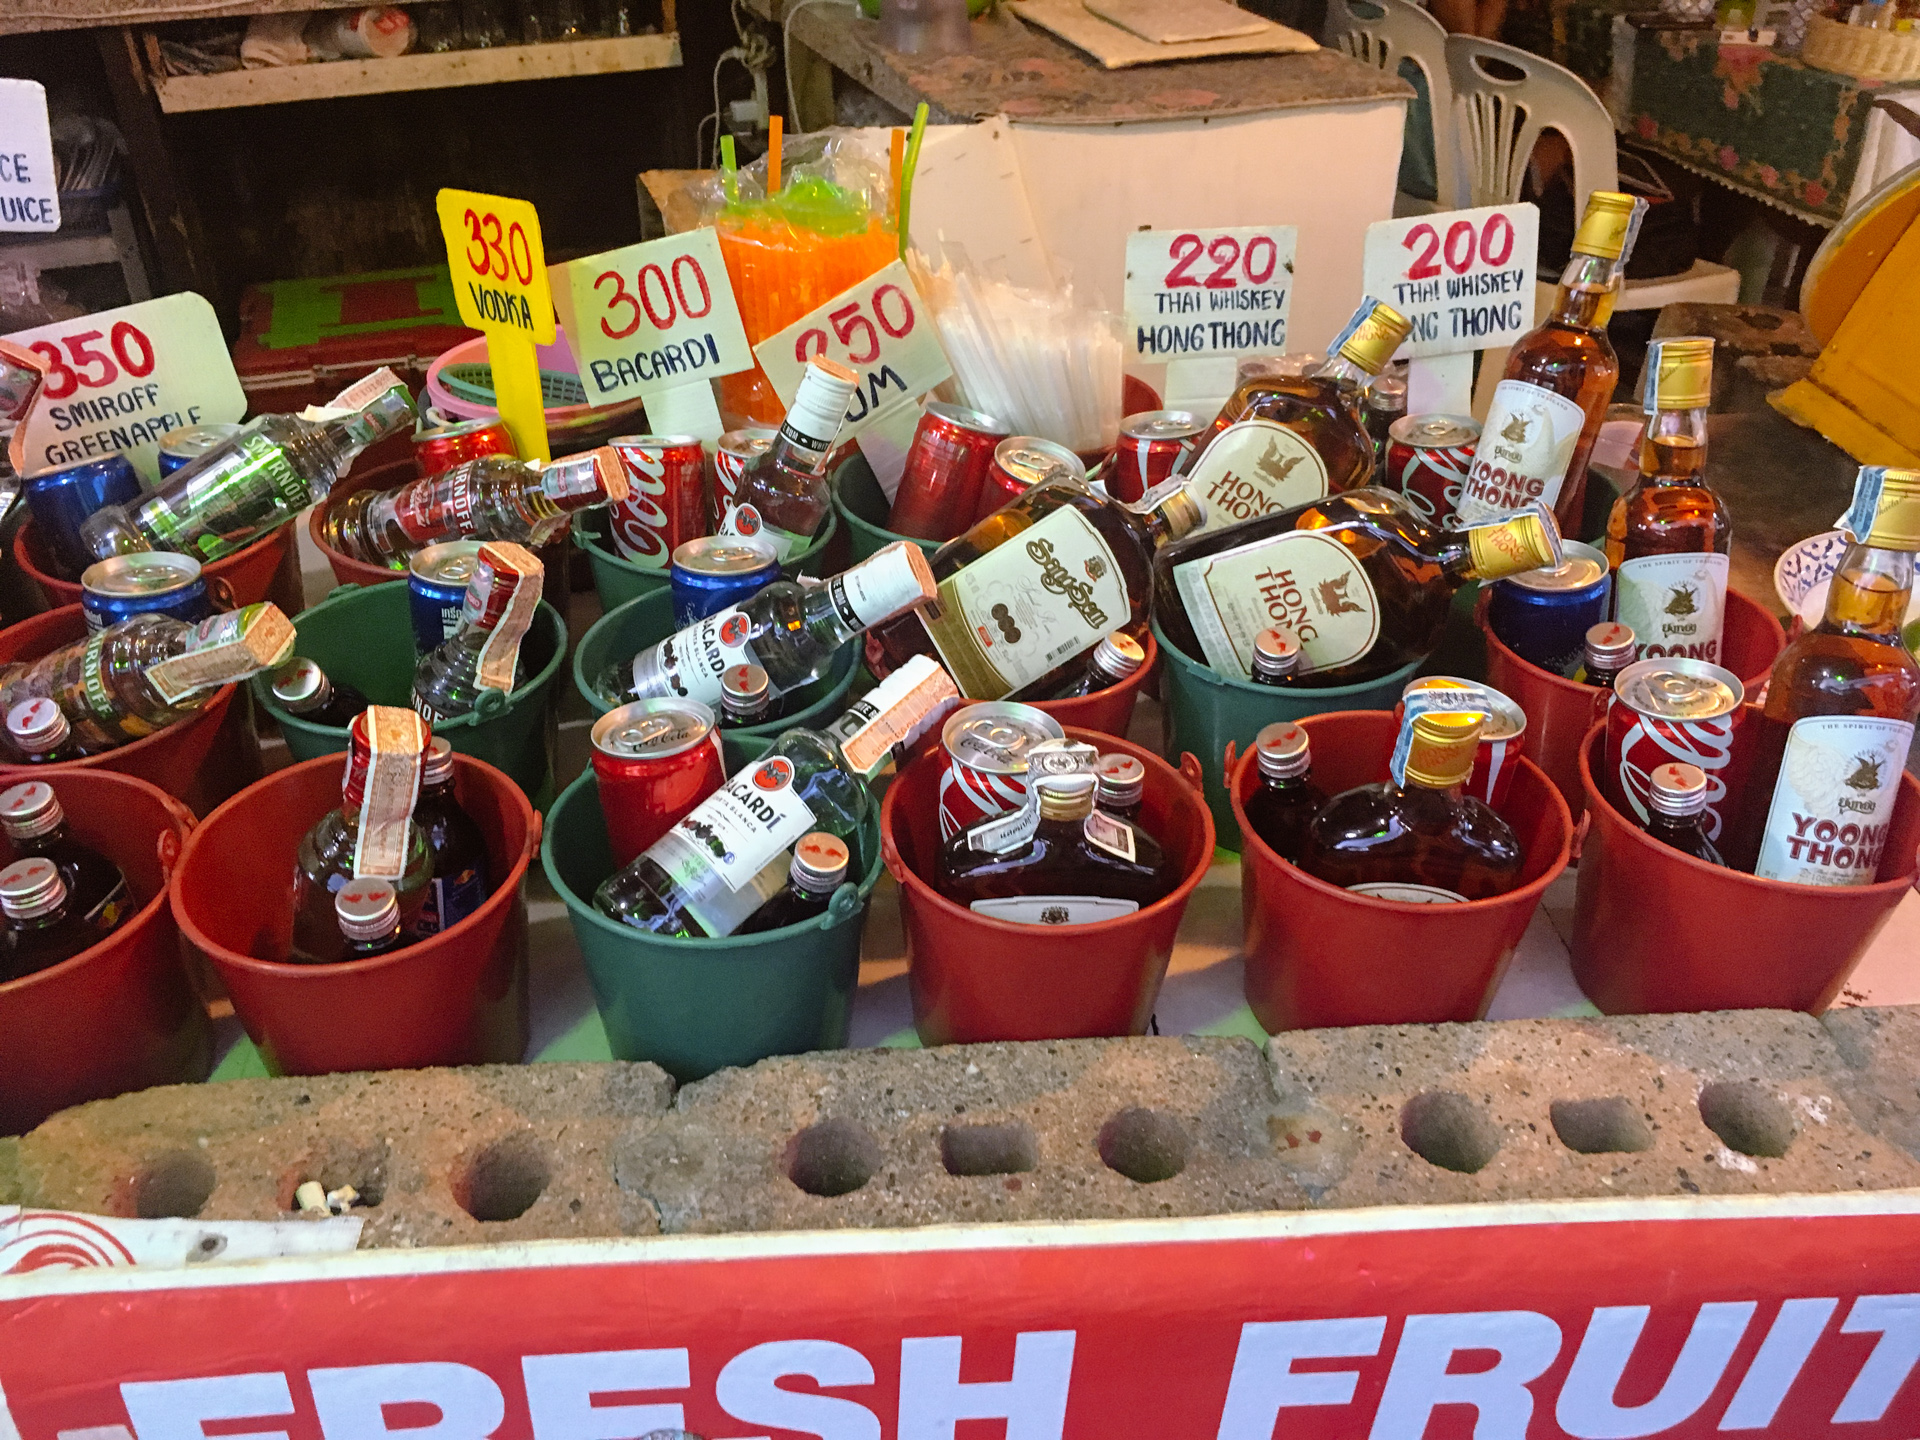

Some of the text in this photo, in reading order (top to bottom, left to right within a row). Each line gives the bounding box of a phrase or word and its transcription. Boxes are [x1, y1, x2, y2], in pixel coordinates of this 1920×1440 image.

[464, 208, 533, 286] 330
[1165, 233, 1278, 289] 220
[1402, 213, 1515, 281] 200
[468, 281, 534, 331] VODKA
[594, 254, 712, 340] 300
[1154, 289, 1286, 315] THAI WHISKEY
[1393, 269, 1524, 307] THAI WHISKEY
[1137, 318, 1286, 354] HONG THONG
[1402, 301, 1522, 343] NG THONG
[28, 320, 155, 400] 350
[590, 333, 720, 393] BACARDI
[49, 382, 159, 432] SMIROFF
[845, 364, 908, 423] UM
[787, 426, 799, 441] RUM
[811, 440, 830, 452] WHIT
[244, 435, 309, 510] SMRNOFF
[453, 460, 474, 530] IRNOFF
[1472, 457, 1545, 497] YOONG
[1498, 525, 1526, 555] HONG
[1254, 565, 1293, 631] THO
[1273, 568, 1319, 643] HONG
[84, 630, 113, 716] IRNOFF
[1821, 723, 1839, 731] THE
[1843, 723, 1873, 731] SPIRIT
[1875, 724, 1887, 732] OF
